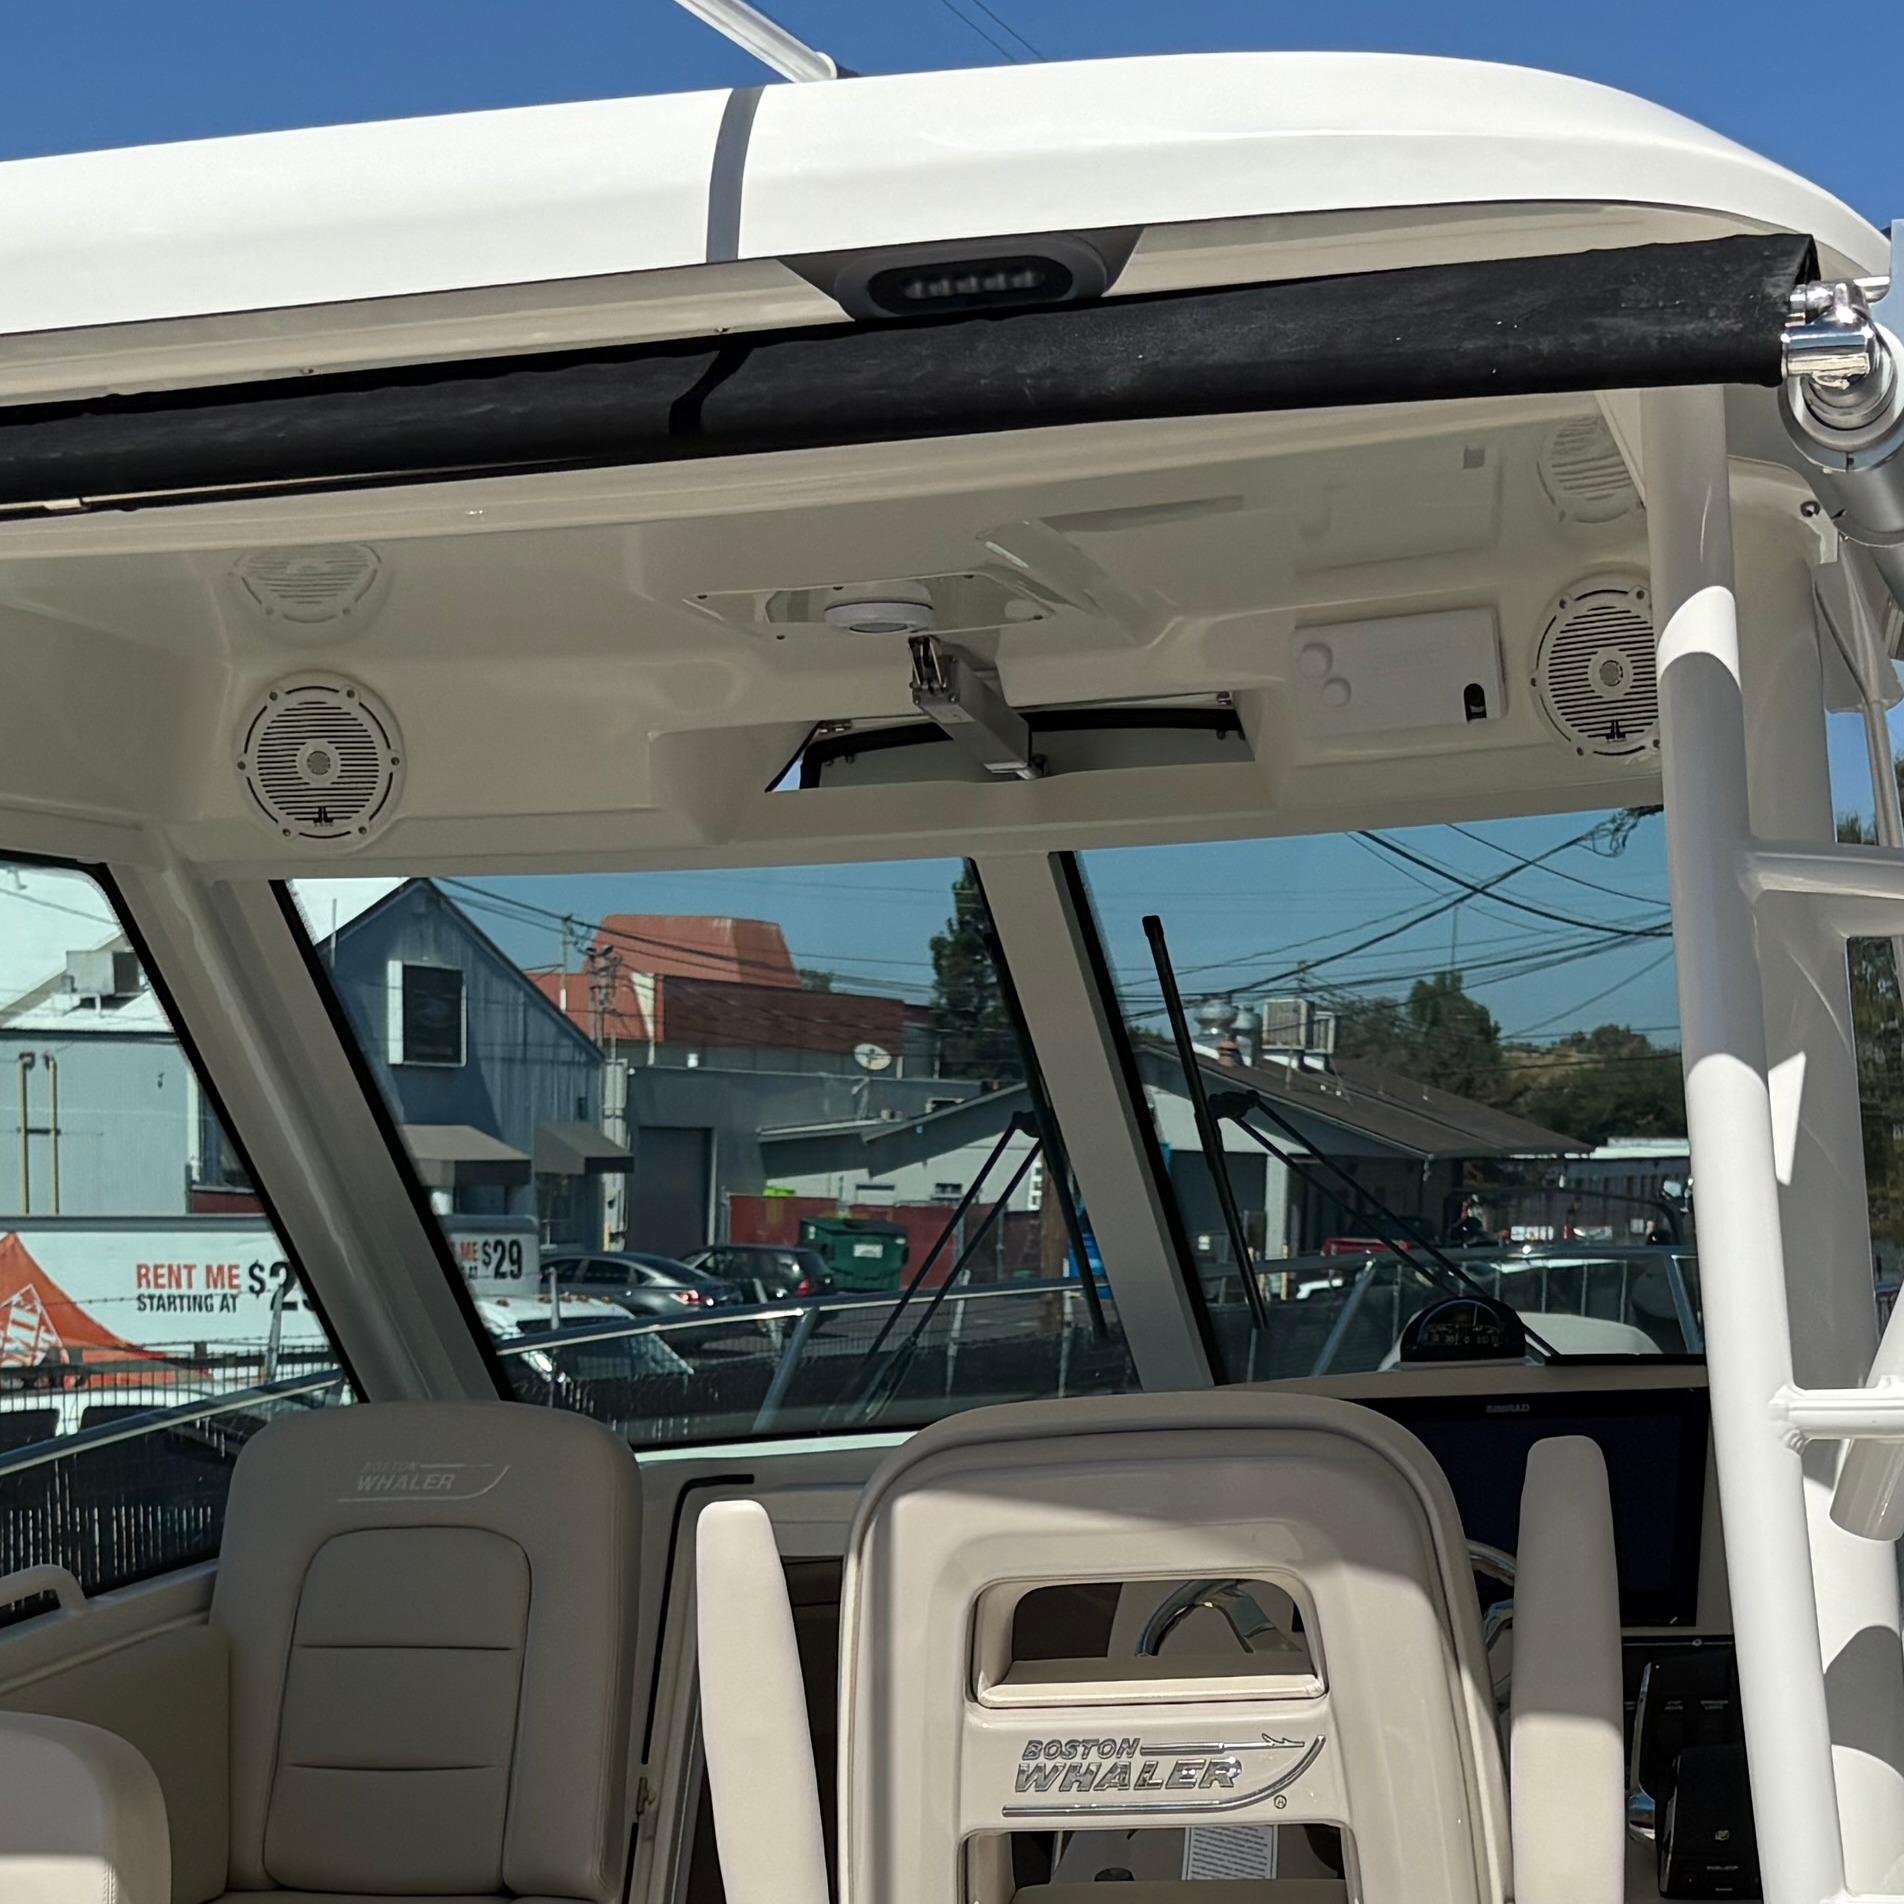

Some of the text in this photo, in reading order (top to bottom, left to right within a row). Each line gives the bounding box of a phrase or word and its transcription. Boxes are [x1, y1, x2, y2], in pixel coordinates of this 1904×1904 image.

[482, 1239, 523, 1280] $29
[136, 1259, 316, 1312] RENT ME $2
[137, 1293, 240, 1313] STARTING AT
[357, 1474, 456, 1491] WHALER
[1021, 1737, 1141, 1761] BOSTON
[1014, 1757, 1243, 1793] WHALER
